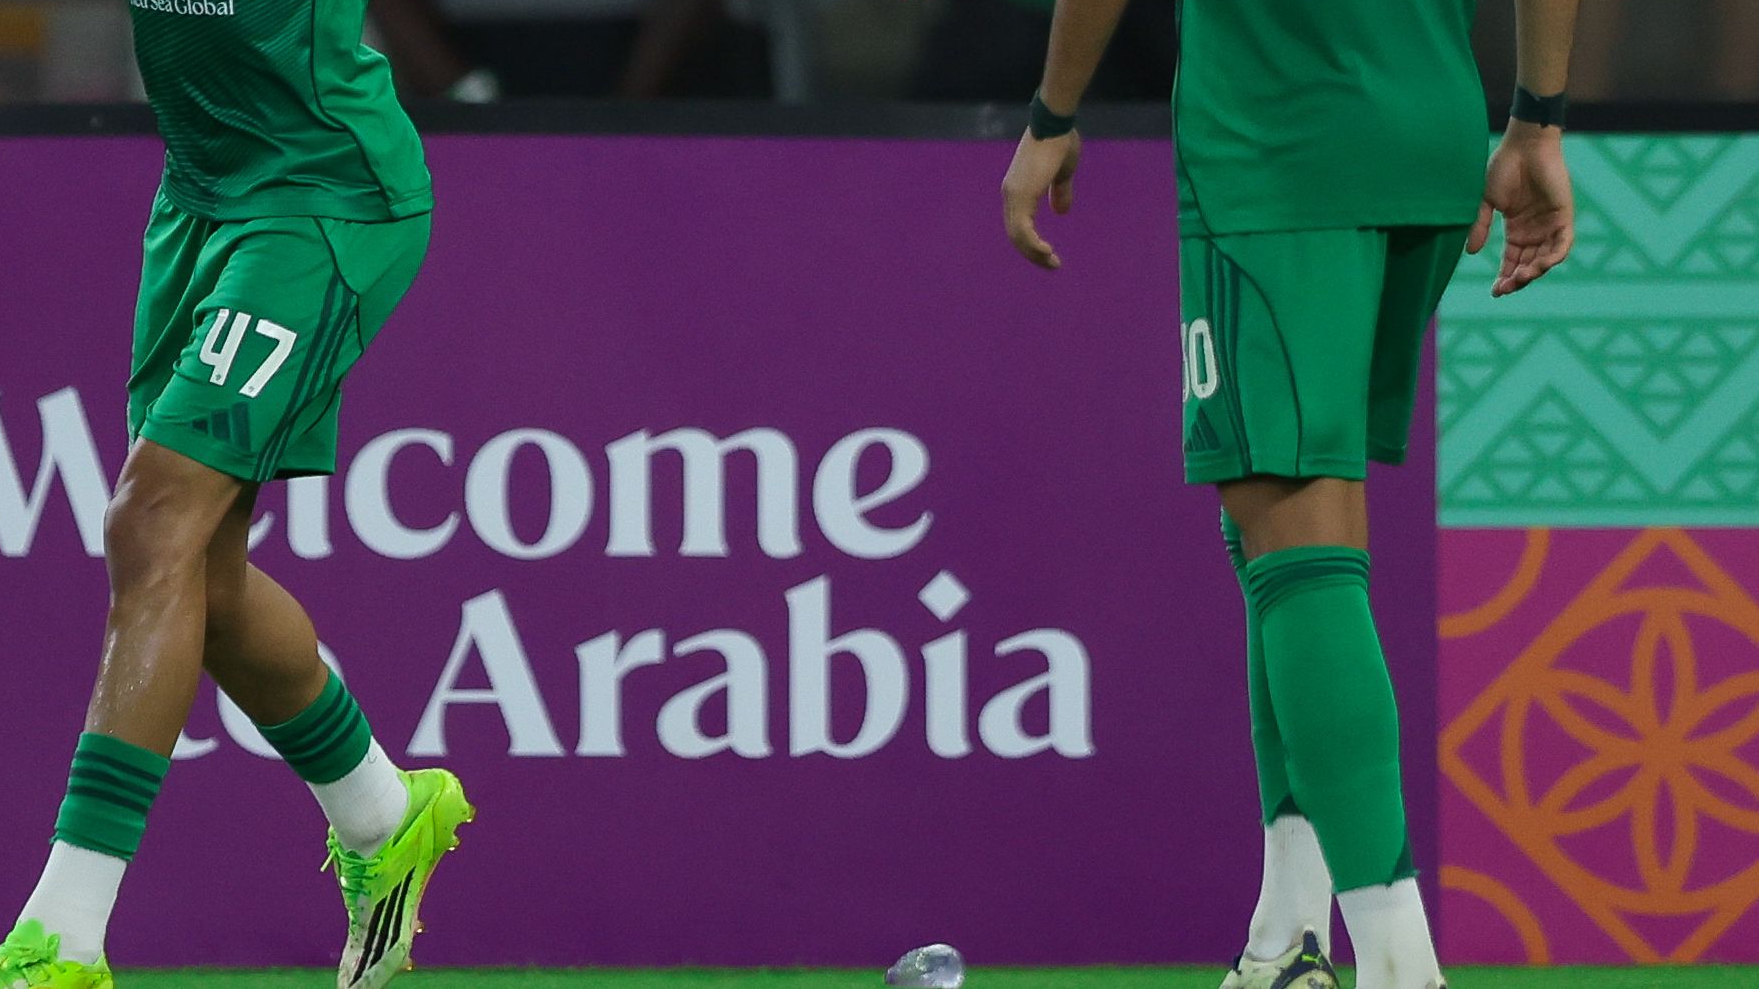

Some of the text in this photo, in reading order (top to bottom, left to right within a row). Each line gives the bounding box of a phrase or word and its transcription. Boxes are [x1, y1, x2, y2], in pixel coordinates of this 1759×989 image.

[199, 308, 297, 398] 47
[1181, 318, 1217, 402] 0
[407, 571, 1094, 758] Arabia
